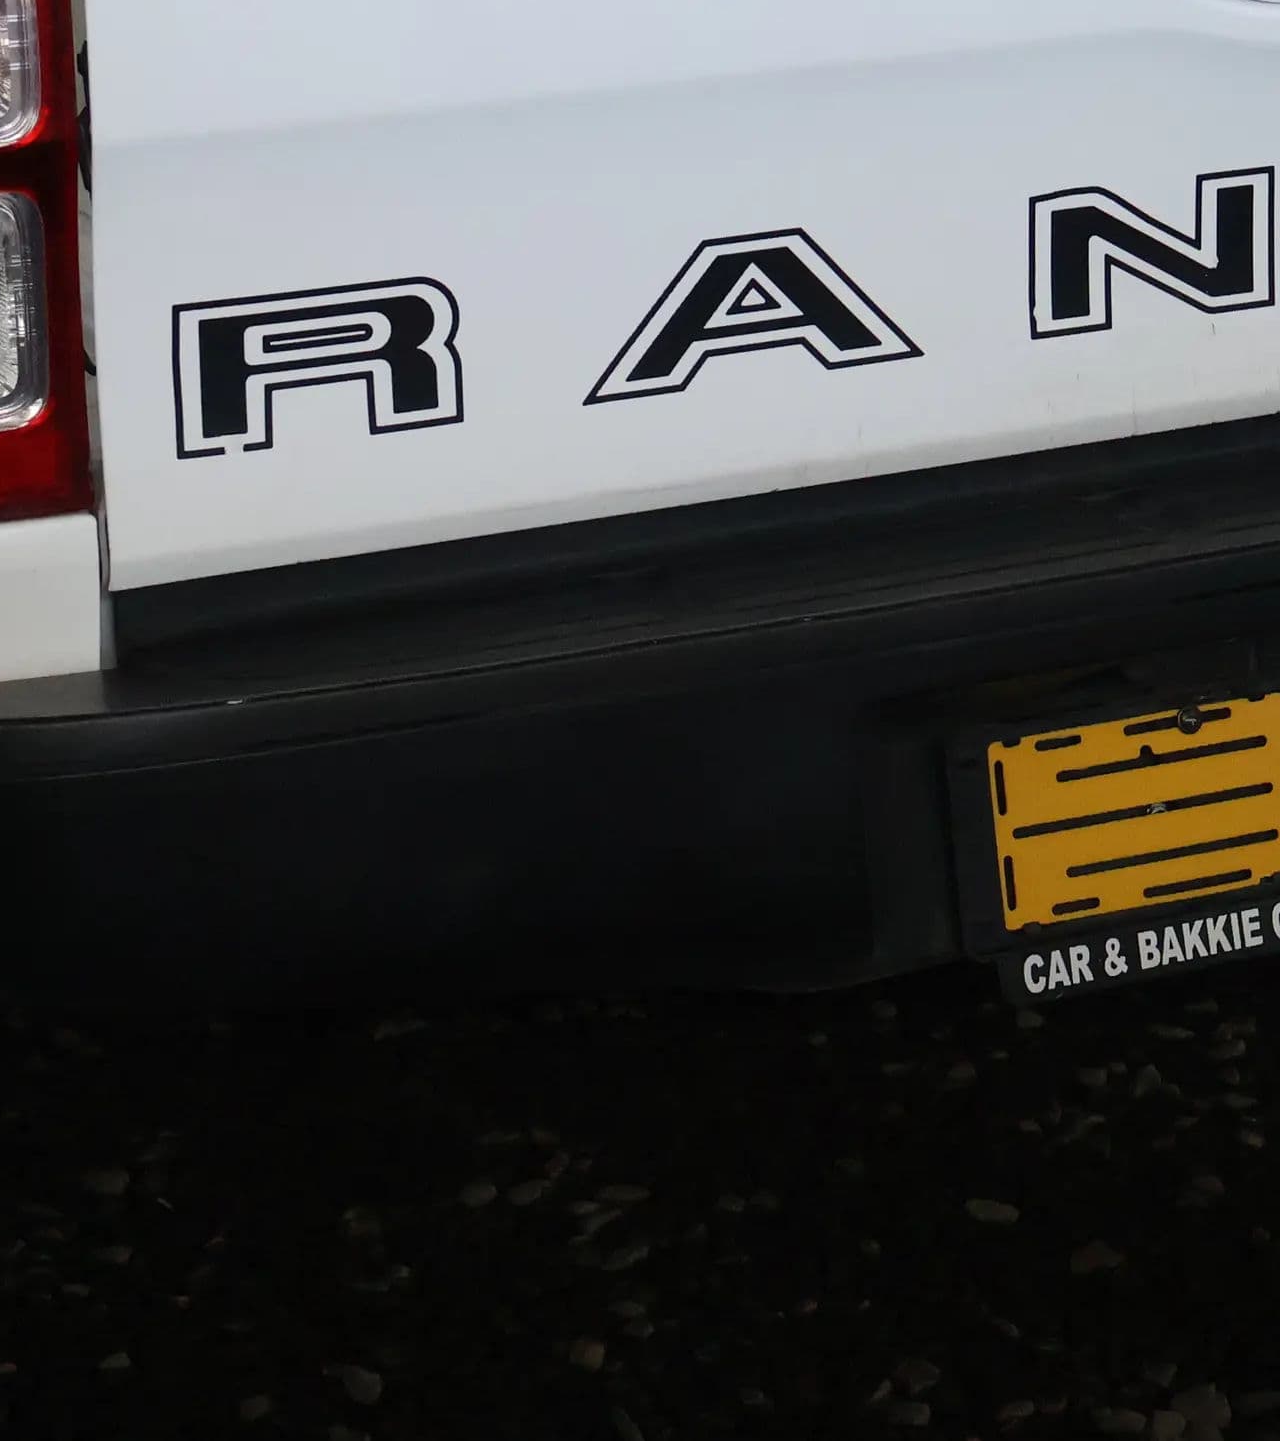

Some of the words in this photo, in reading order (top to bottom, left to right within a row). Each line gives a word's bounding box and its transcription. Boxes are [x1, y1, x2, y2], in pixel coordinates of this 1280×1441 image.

[1023, 944, 1094, 995] CAR
[1103, 937, 1129, 978] &
[1137, 908, 1264, 970] BAKKIE
